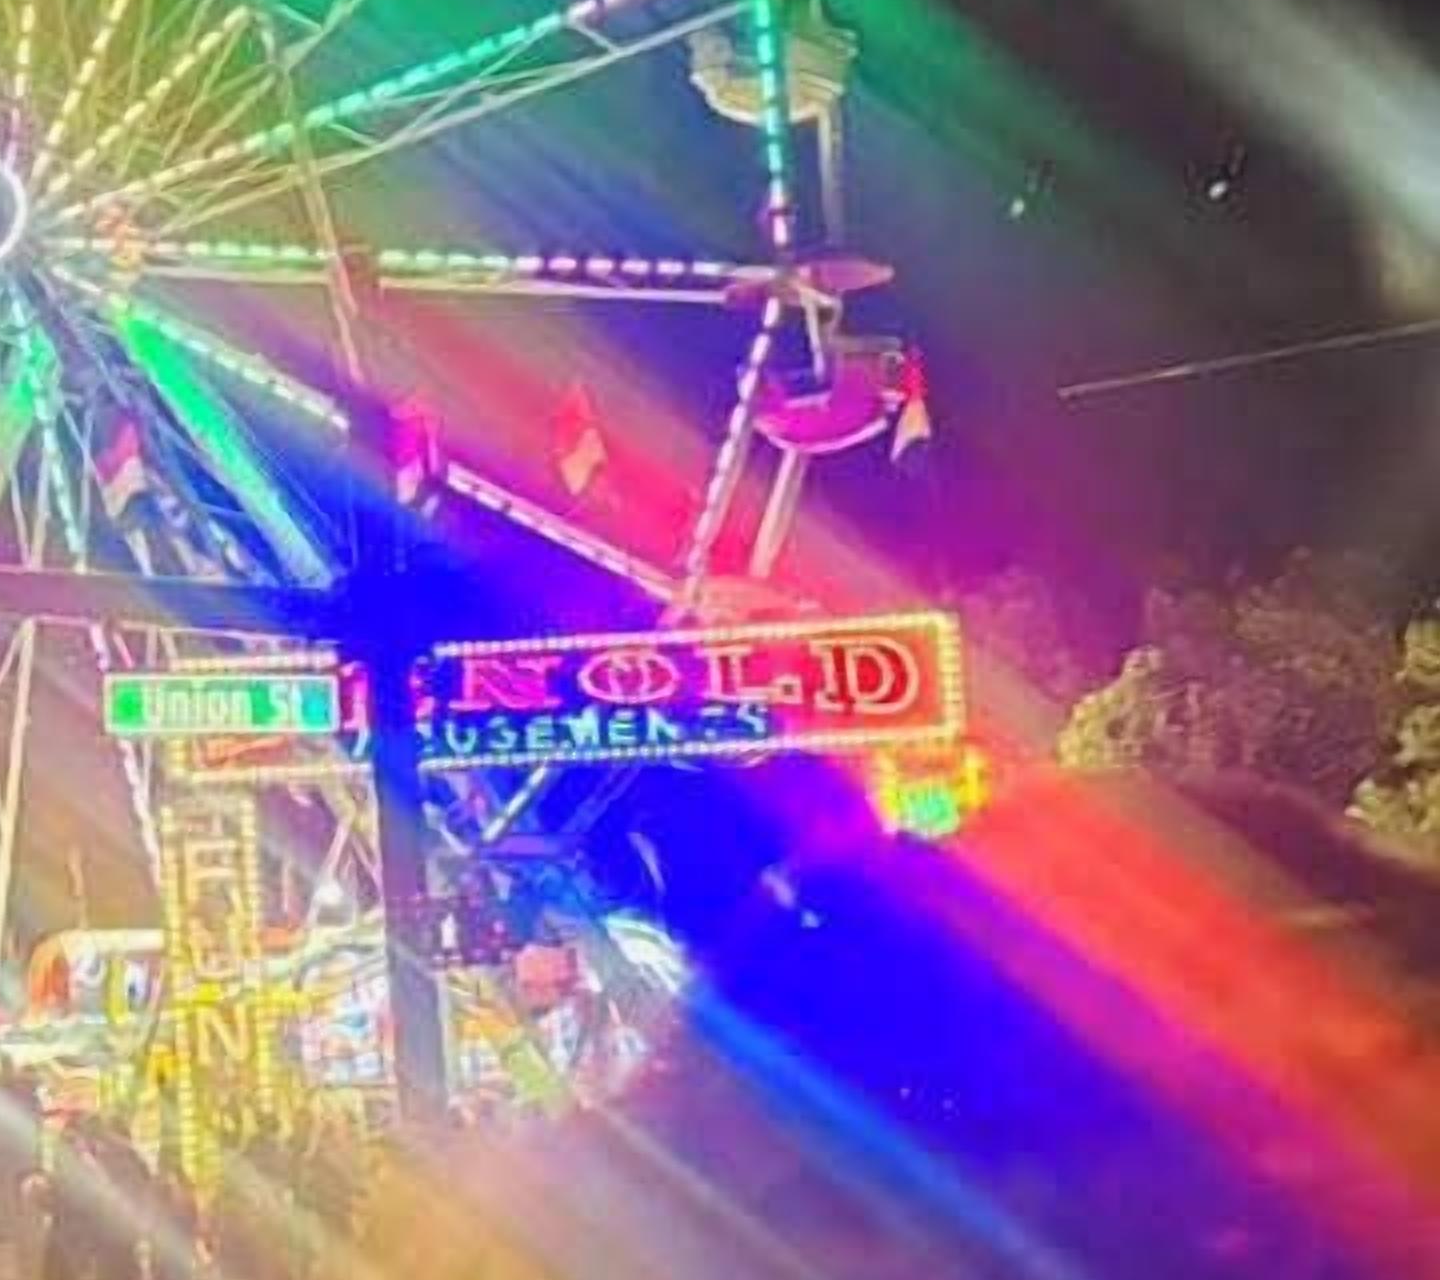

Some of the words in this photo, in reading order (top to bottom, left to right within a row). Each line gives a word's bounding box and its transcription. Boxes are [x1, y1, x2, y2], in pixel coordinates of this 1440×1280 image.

[144, 679, 250, 729] Union
[268, 681, 306, 728] St
[341, 634, 919, 730] NOLD
